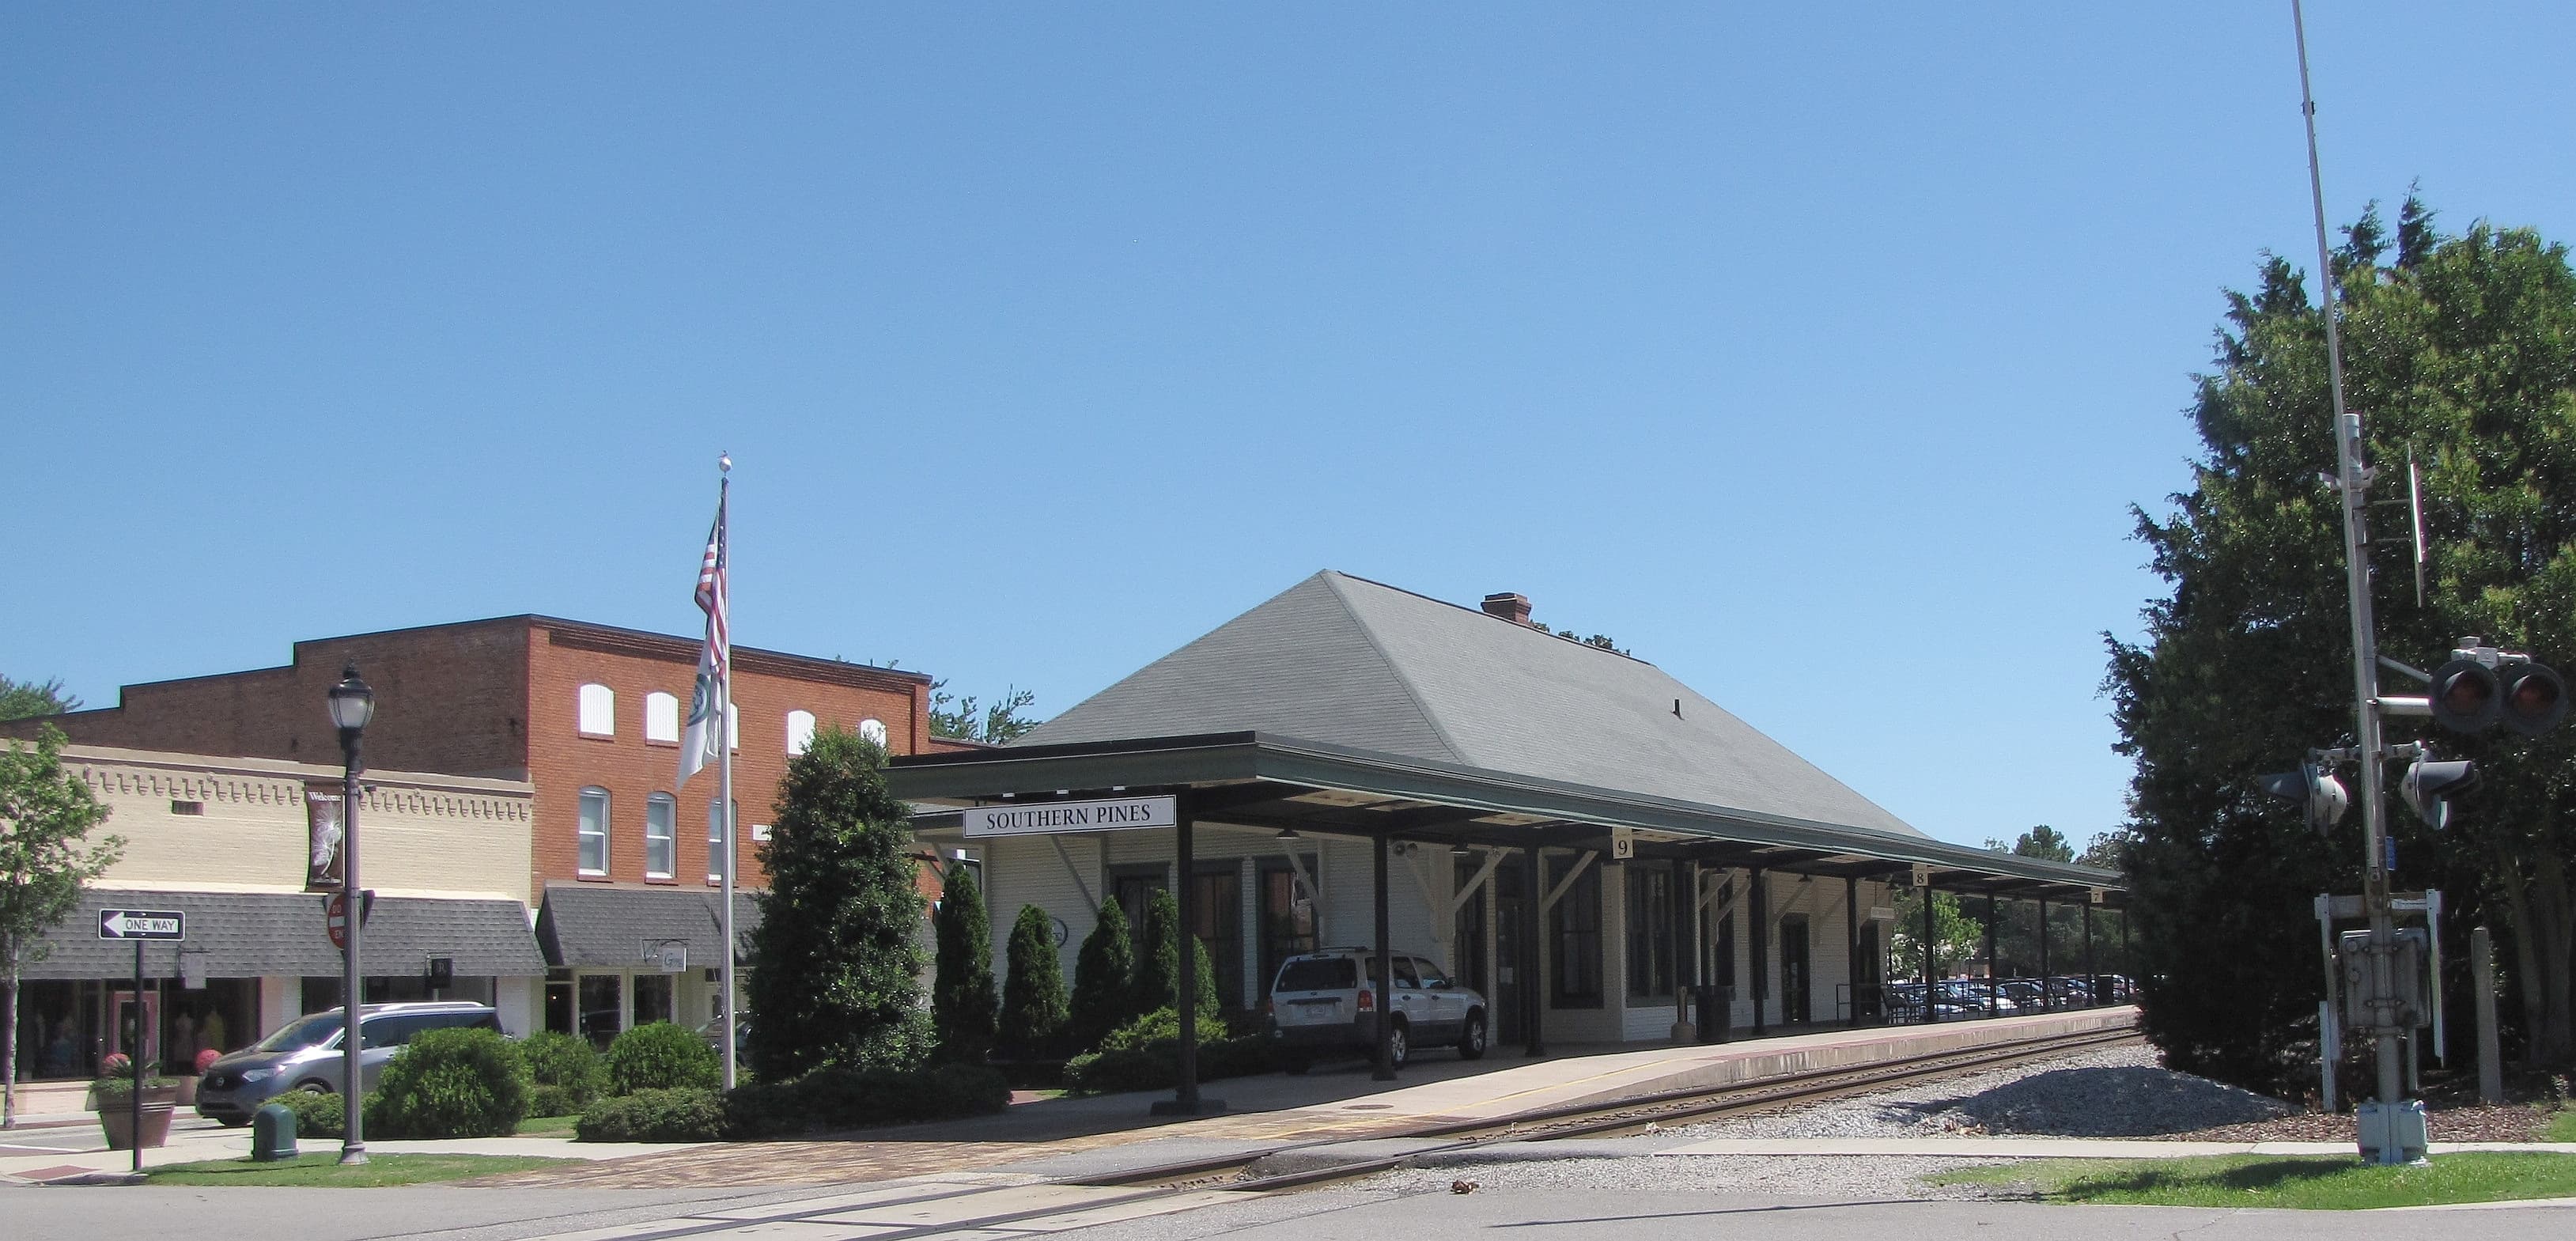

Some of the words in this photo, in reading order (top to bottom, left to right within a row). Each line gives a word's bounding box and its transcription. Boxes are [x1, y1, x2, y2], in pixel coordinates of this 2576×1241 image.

[308, 791, 341, 801] Welcome
[986, 808, 1088, 830] SOUTHERN
[1097, 804, 1151, 823] PINES
[1618, 840, 1628, 855] 9
[1917, 872, 1924, 884] 8
[126, 919, 148, 931] ONE
[152, 920, 175, 931] WAY
